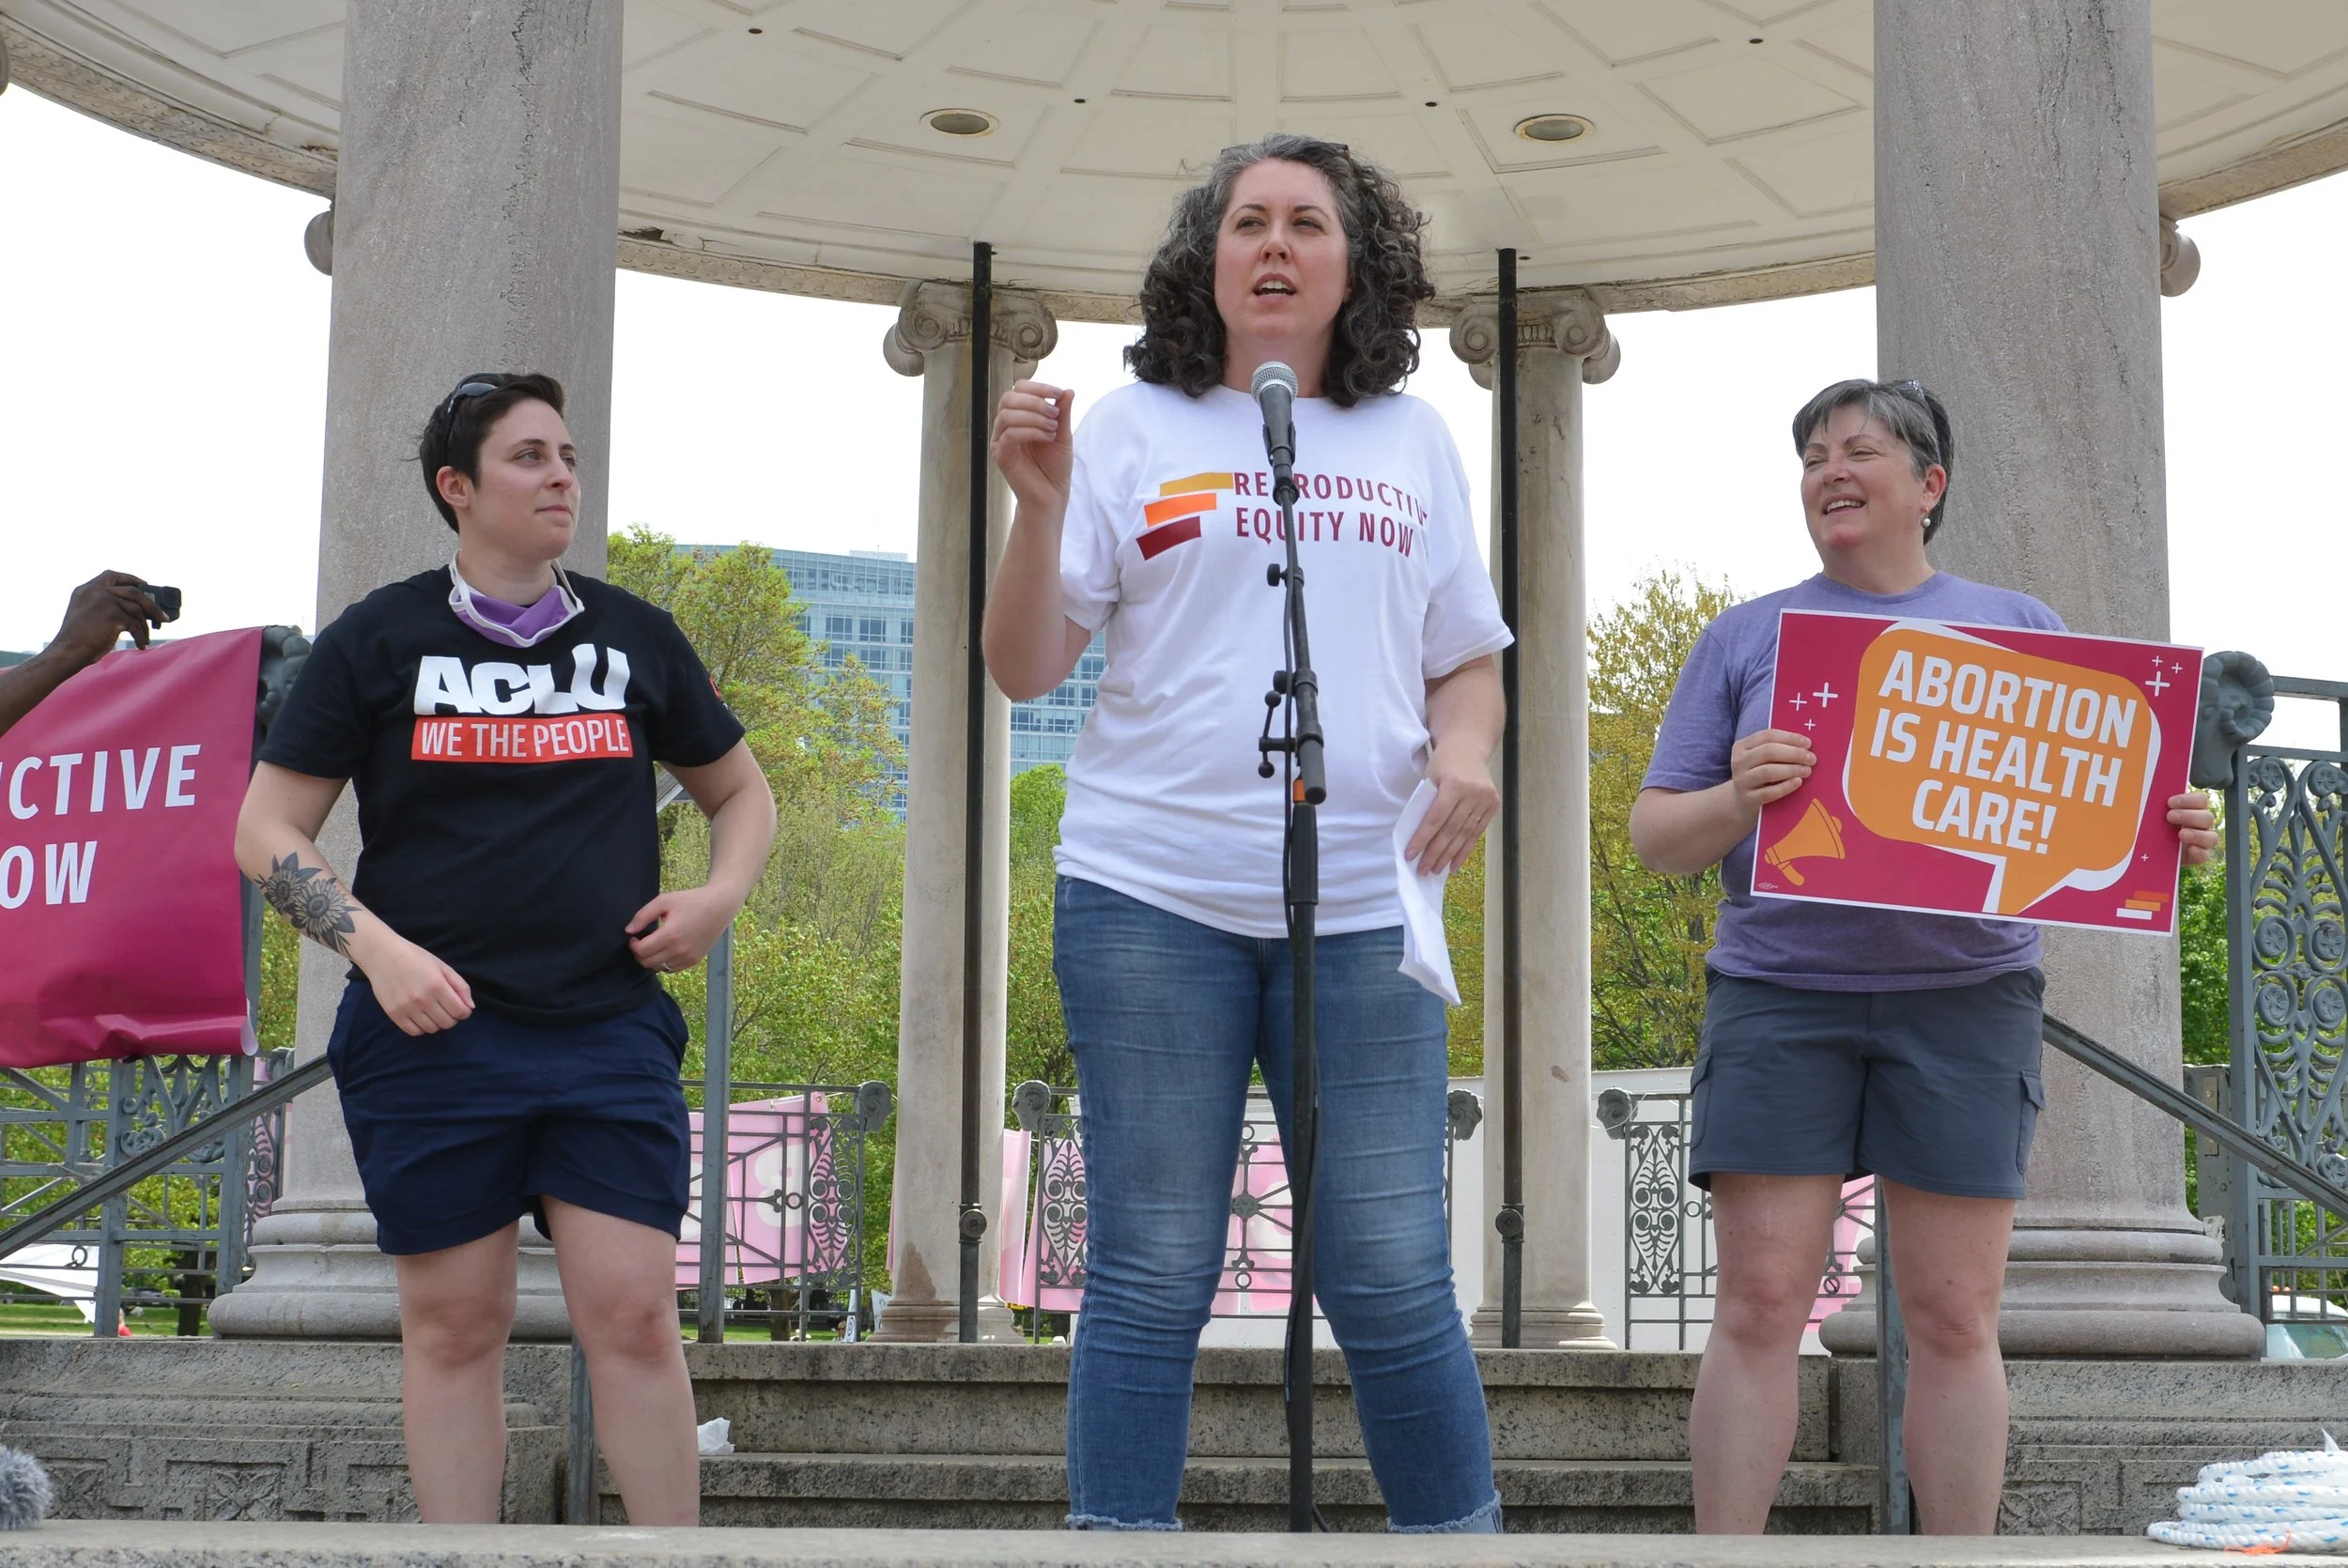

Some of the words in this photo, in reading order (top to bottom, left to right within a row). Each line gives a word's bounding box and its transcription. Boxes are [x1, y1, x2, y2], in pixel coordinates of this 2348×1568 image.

[1233, 471, 1429, 527] RERODUCTIV
[1359, 512, 1413, 559] NOW
[413, 643, 630, 715] ACLU
[1878, 650, 2138, 748] ABORTION
[422, 721, 462, 756] WE
[471, 723, 526, 757] THE
[533, 718, 629, 757] PEOPLE
[1870, 708, 1922, 763] IS
[1929, 720, 2123, 807] HEALTH
[0, 744, 201, 821] CTIVE
[1911, 779, 2058, 854] CARE!
